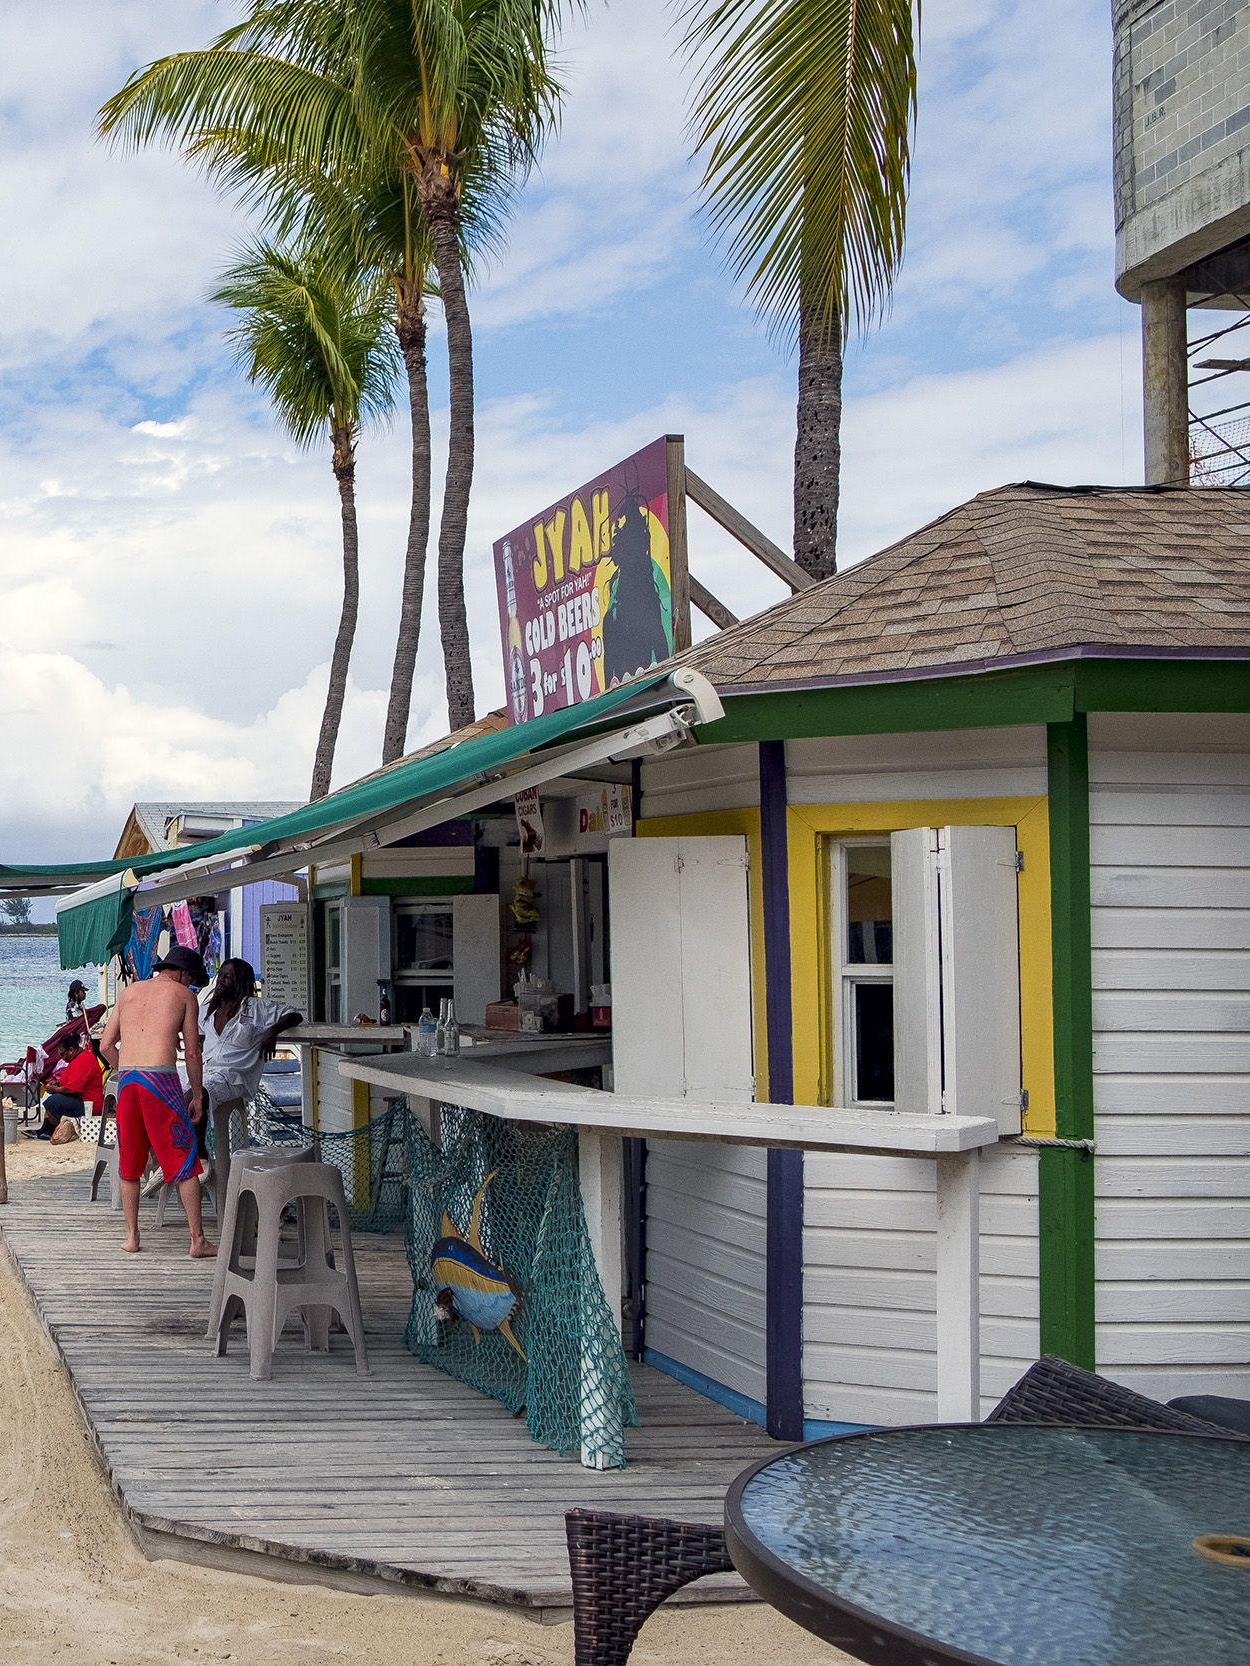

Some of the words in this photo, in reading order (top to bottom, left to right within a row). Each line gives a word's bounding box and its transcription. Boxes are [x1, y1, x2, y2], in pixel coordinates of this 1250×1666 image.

[1145, 106, 1166, 127] J.B.R.
[532, 488, 610, 592] JYAH
[544, 588, 560, 608] SPOT
[560, 581, 574, 599] FOR
[525, 610, 556, 657] COLD
[557, 586, 601, 643] BEERS
[530, 657, 545, 718] 3
[543, 671, 558, 697] for
[517, 803, 538, 817] CIGARS
[610, 798, 619, 809] FOR
[610, 812, 623, 828] $10
[277, 914, 292, 922] JYAH
